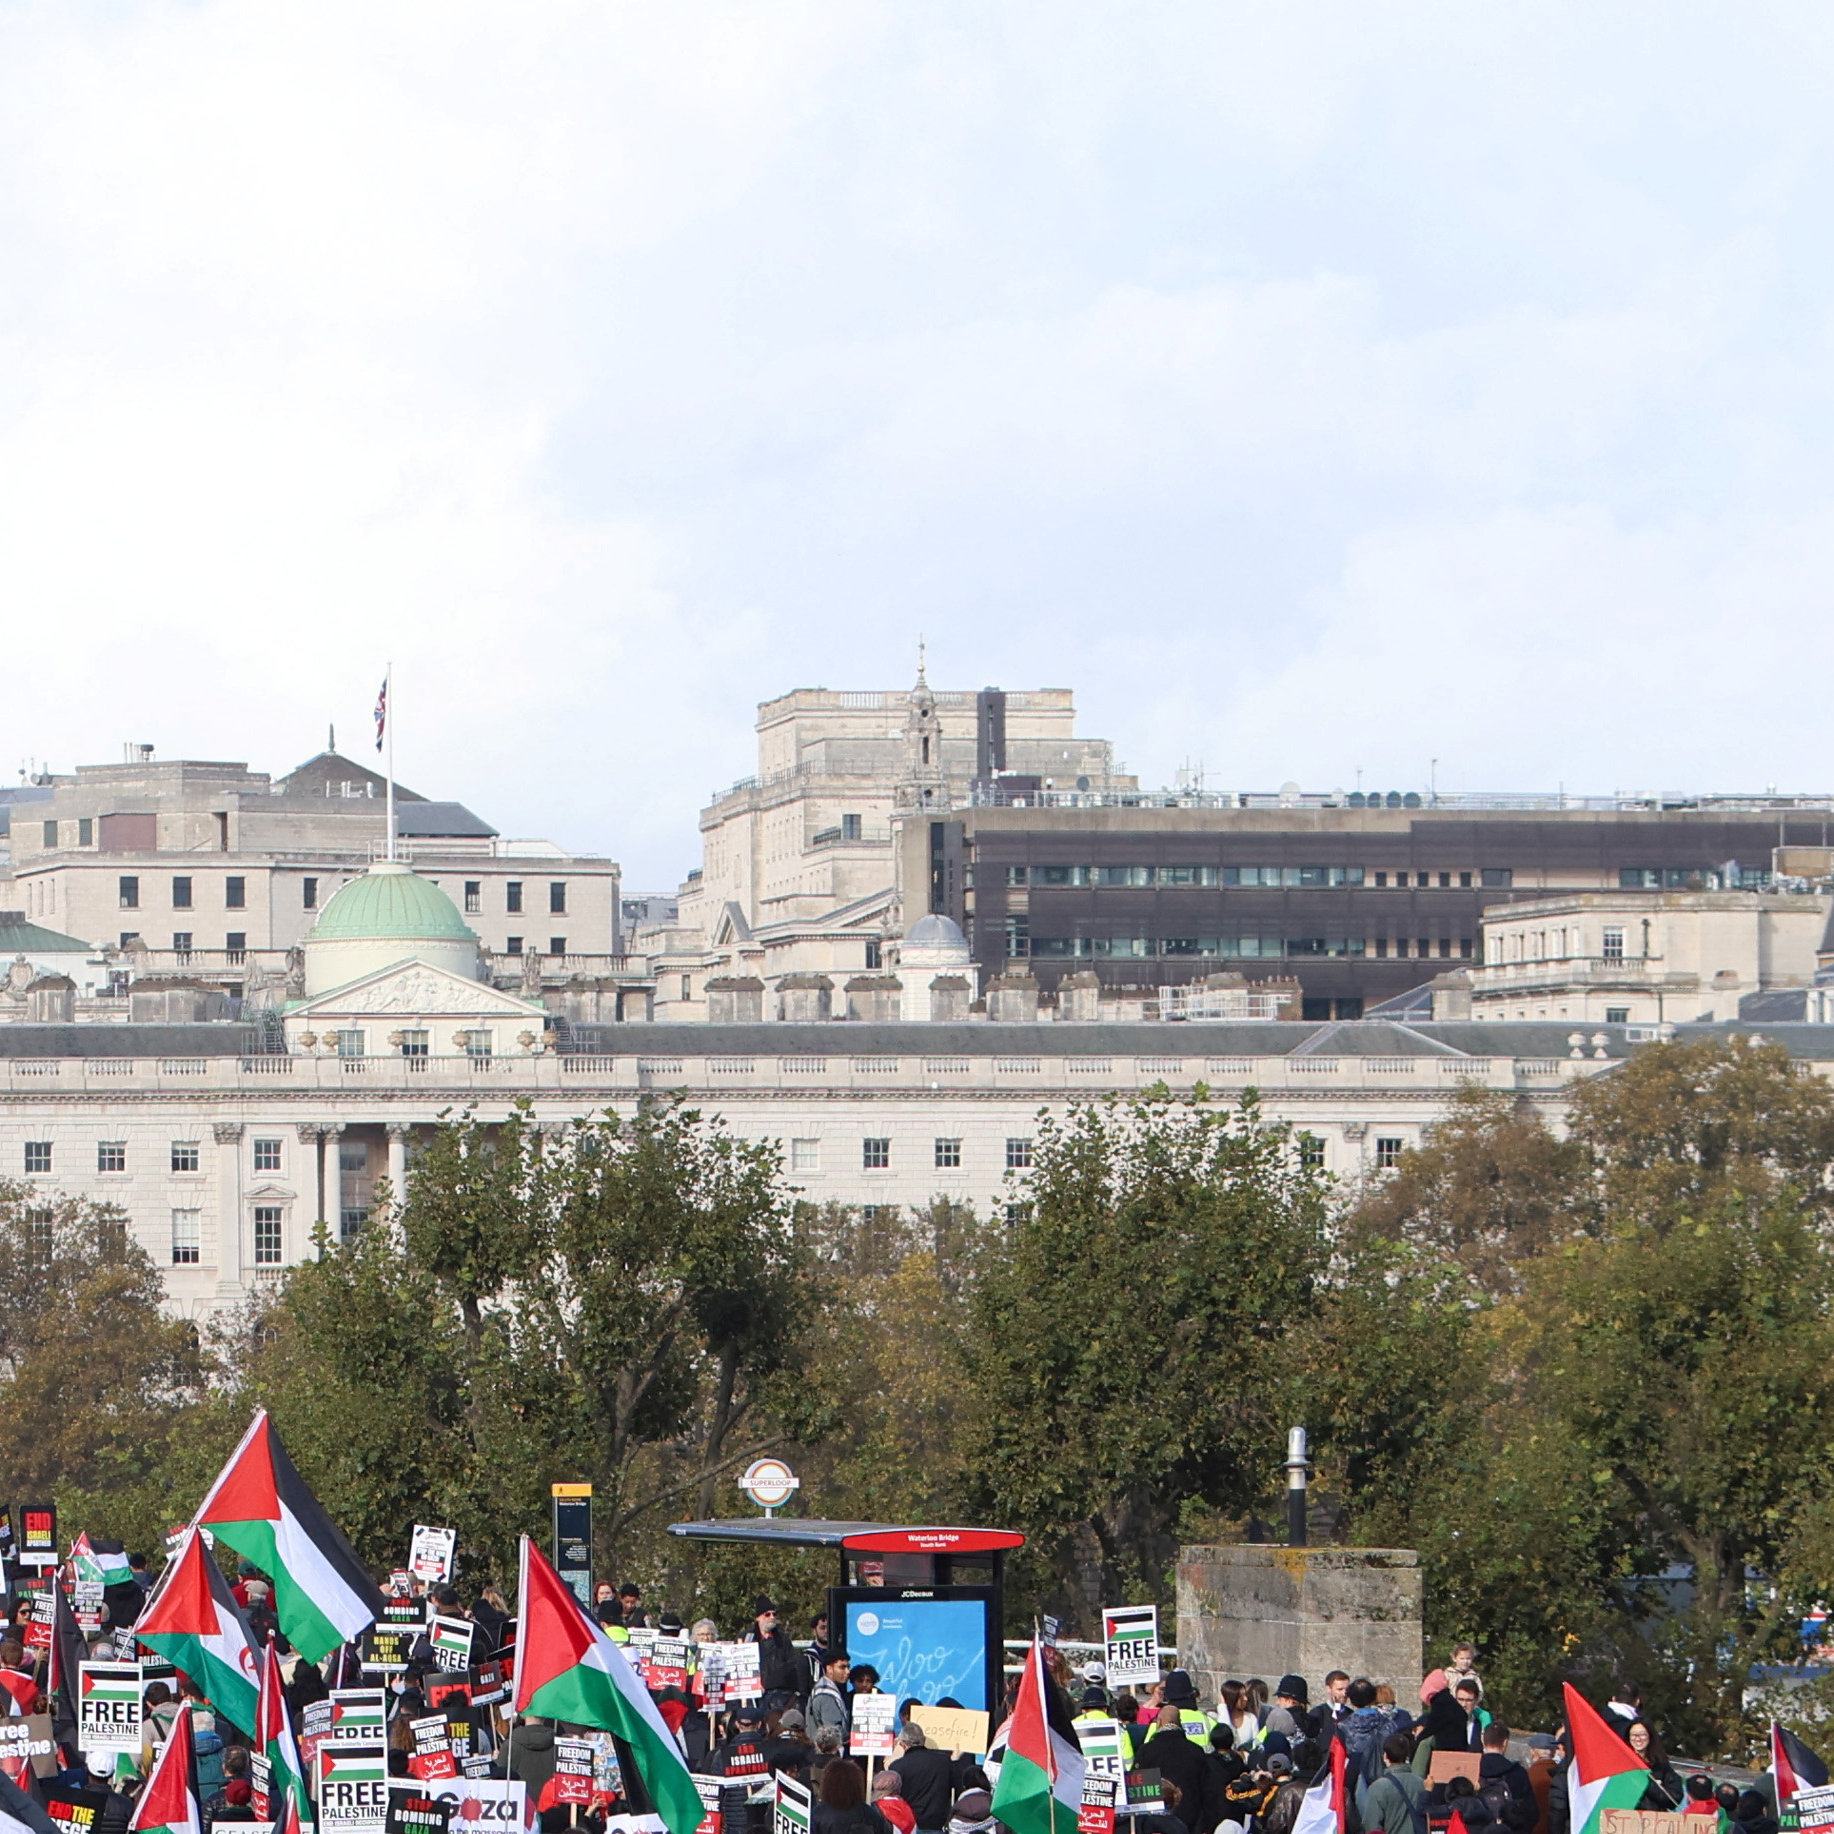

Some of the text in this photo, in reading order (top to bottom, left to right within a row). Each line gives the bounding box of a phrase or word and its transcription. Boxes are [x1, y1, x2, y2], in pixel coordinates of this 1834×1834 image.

[750, 1479, 792, 1487] SUPERLOOP
[908, 1534, 959, 1542] Waterloo Bridge
[394, 1809, 442, 1826] BOMBING
